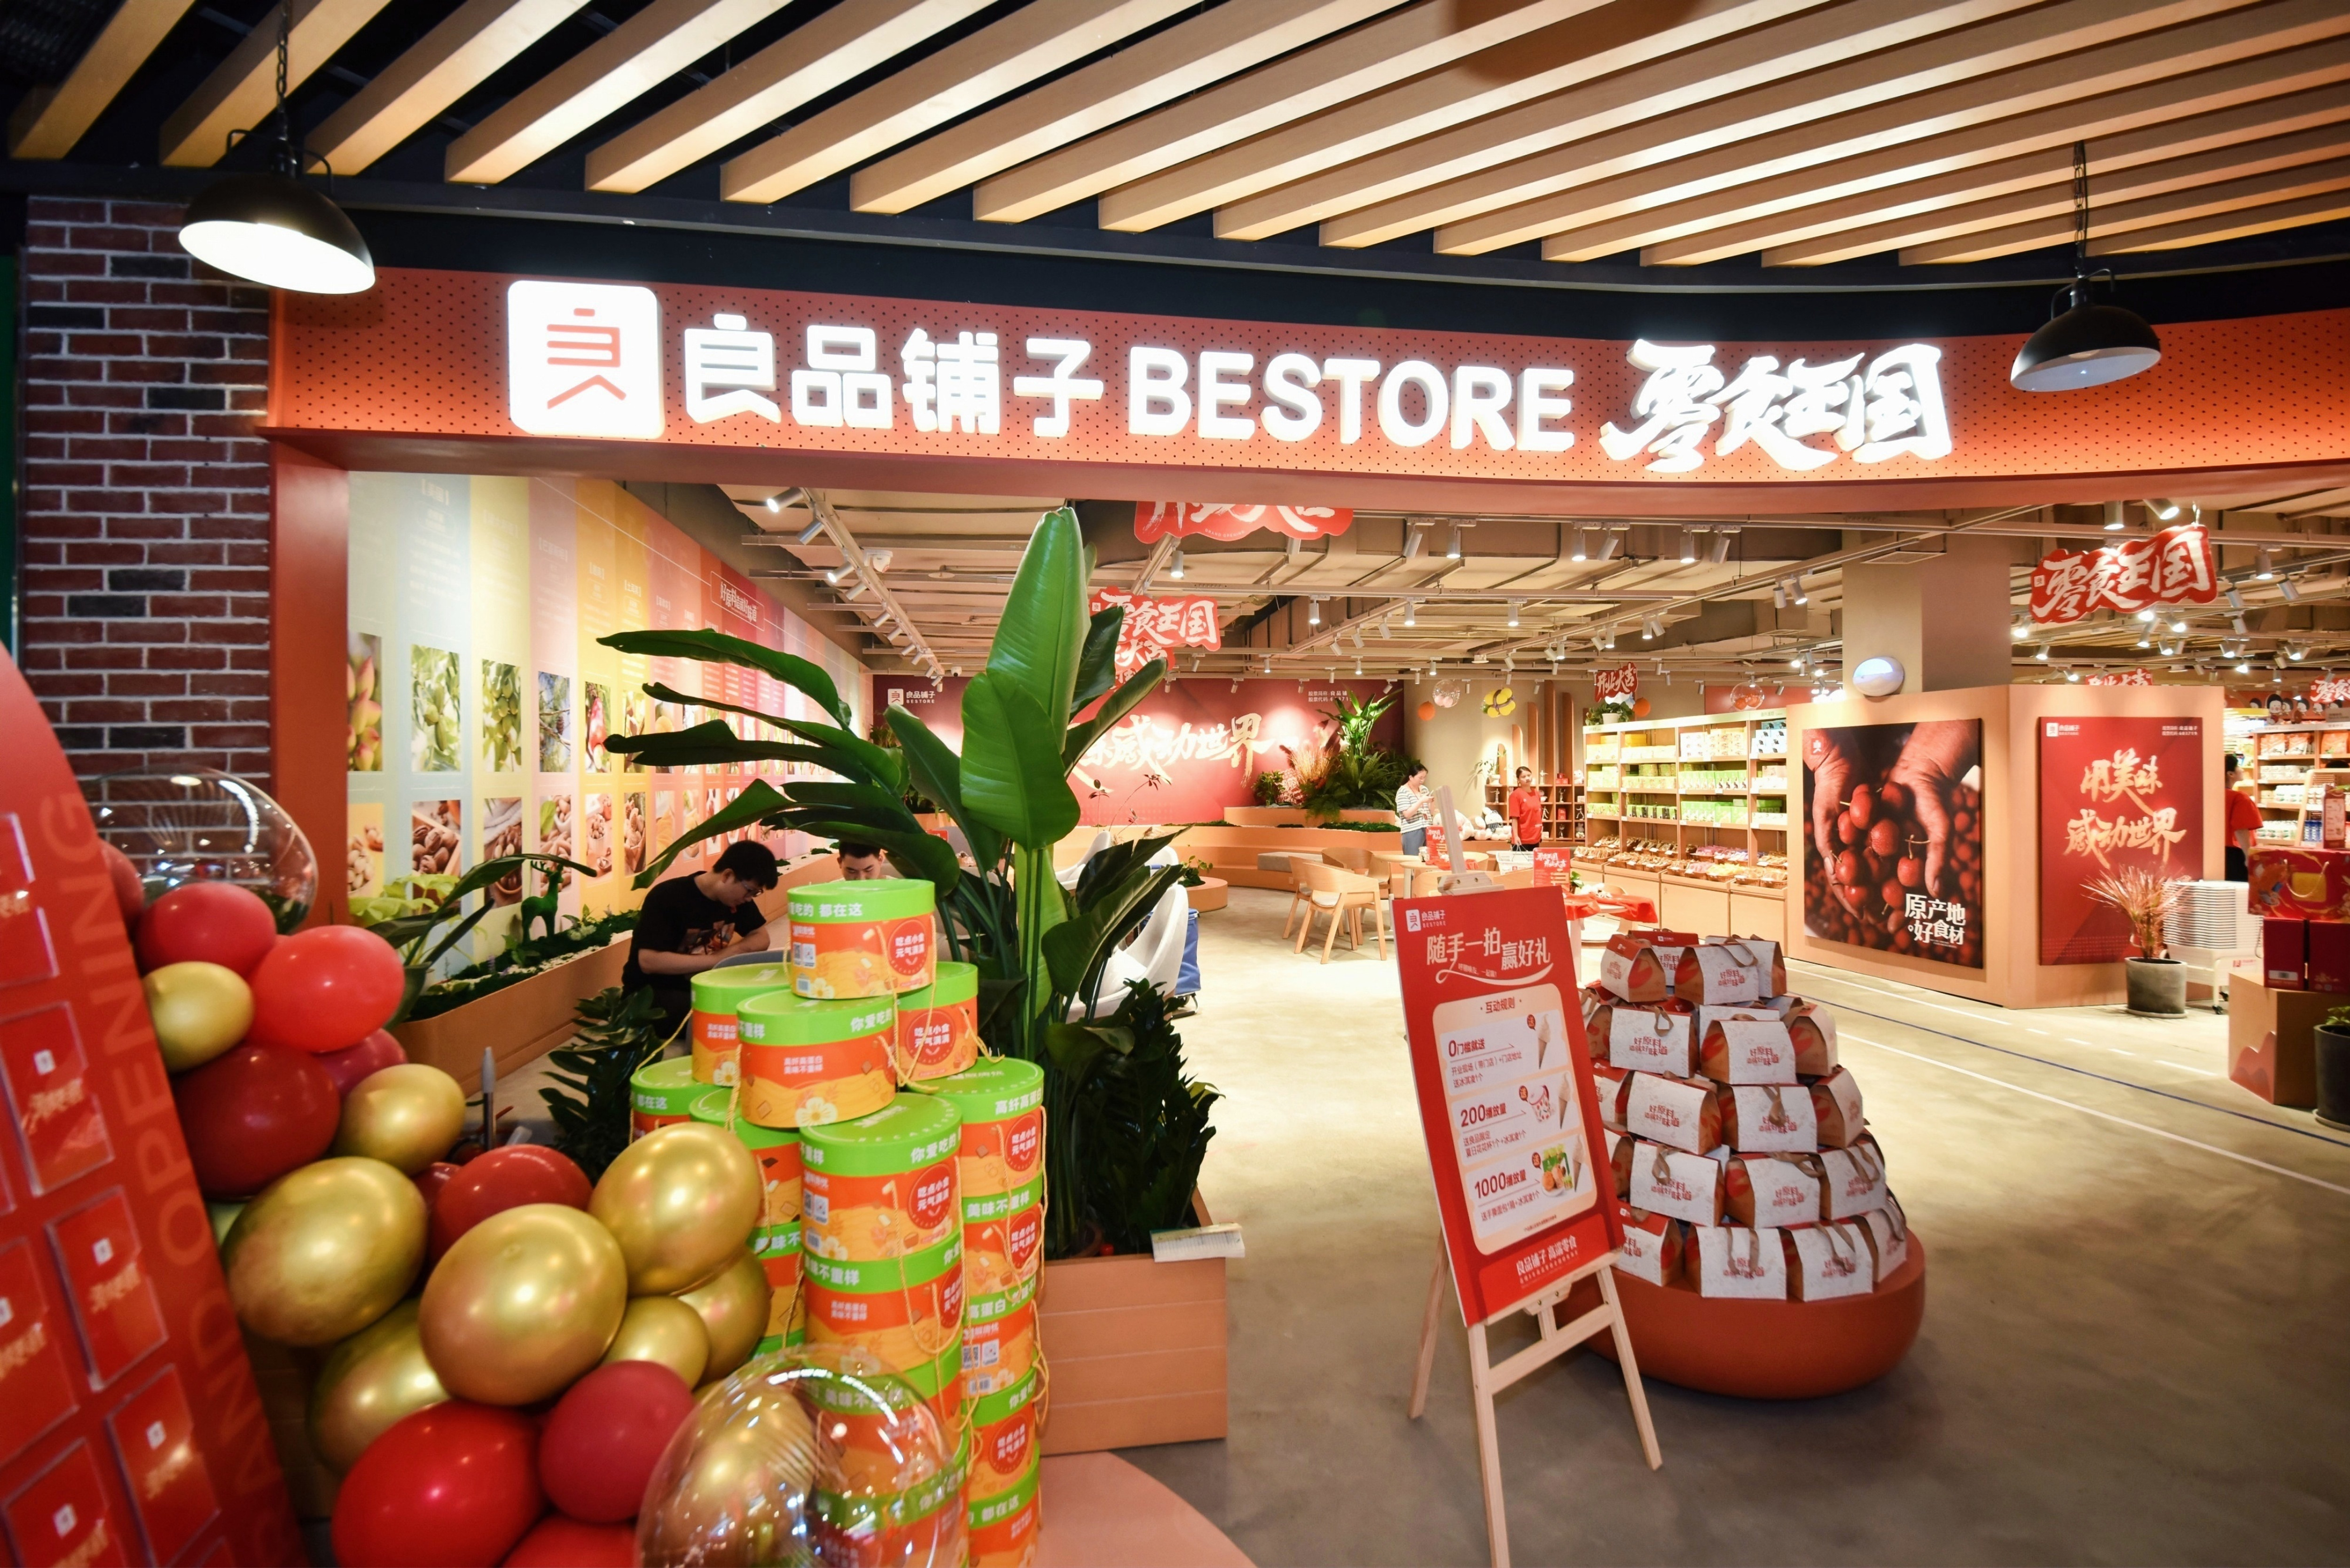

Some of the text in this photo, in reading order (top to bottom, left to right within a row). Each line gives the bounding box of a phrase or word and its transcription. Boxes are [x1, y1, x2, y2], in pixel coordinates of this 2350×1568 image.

[685, 313, 1104, 438] 良品铺子
[1128, 345, 1575, 453] BESTORE
[1599, 338, 1952, 473] 零食王国
[2310, 678, 2350, 703] 零食
[2064, 808, 2187, 870] 感动世界
[819, 902, 863, 917] 都在这
[1421, 910, 1446, 921] 良品铺子
[1904, 893, 1966, 926] 原产地
[1913, 919, 1965, 945] 好食材
[1427, 927, 1551, 971] 随手一拍 赢好礼
[1485, 997, 1515, 1014] 互动规则
[1448, 1038, 1485, 1057] 0门槛就送
[1634, 1036, 1661, 1048] 好原料
[1750, 1046, 1772, 1057] 好原料
[1460, 1103, 1507, 1128] 200播放量
[1649, 1105, 1674, 1118] 好原料
[1474, 1169, 1527, 1199] 1000播放量
[967, 1190, 1030, 1218] 美味不重样
[1516, 1249, 1546, 1277] 良品铺子
[1547, 1235, 1577, 1261] 高端零食
